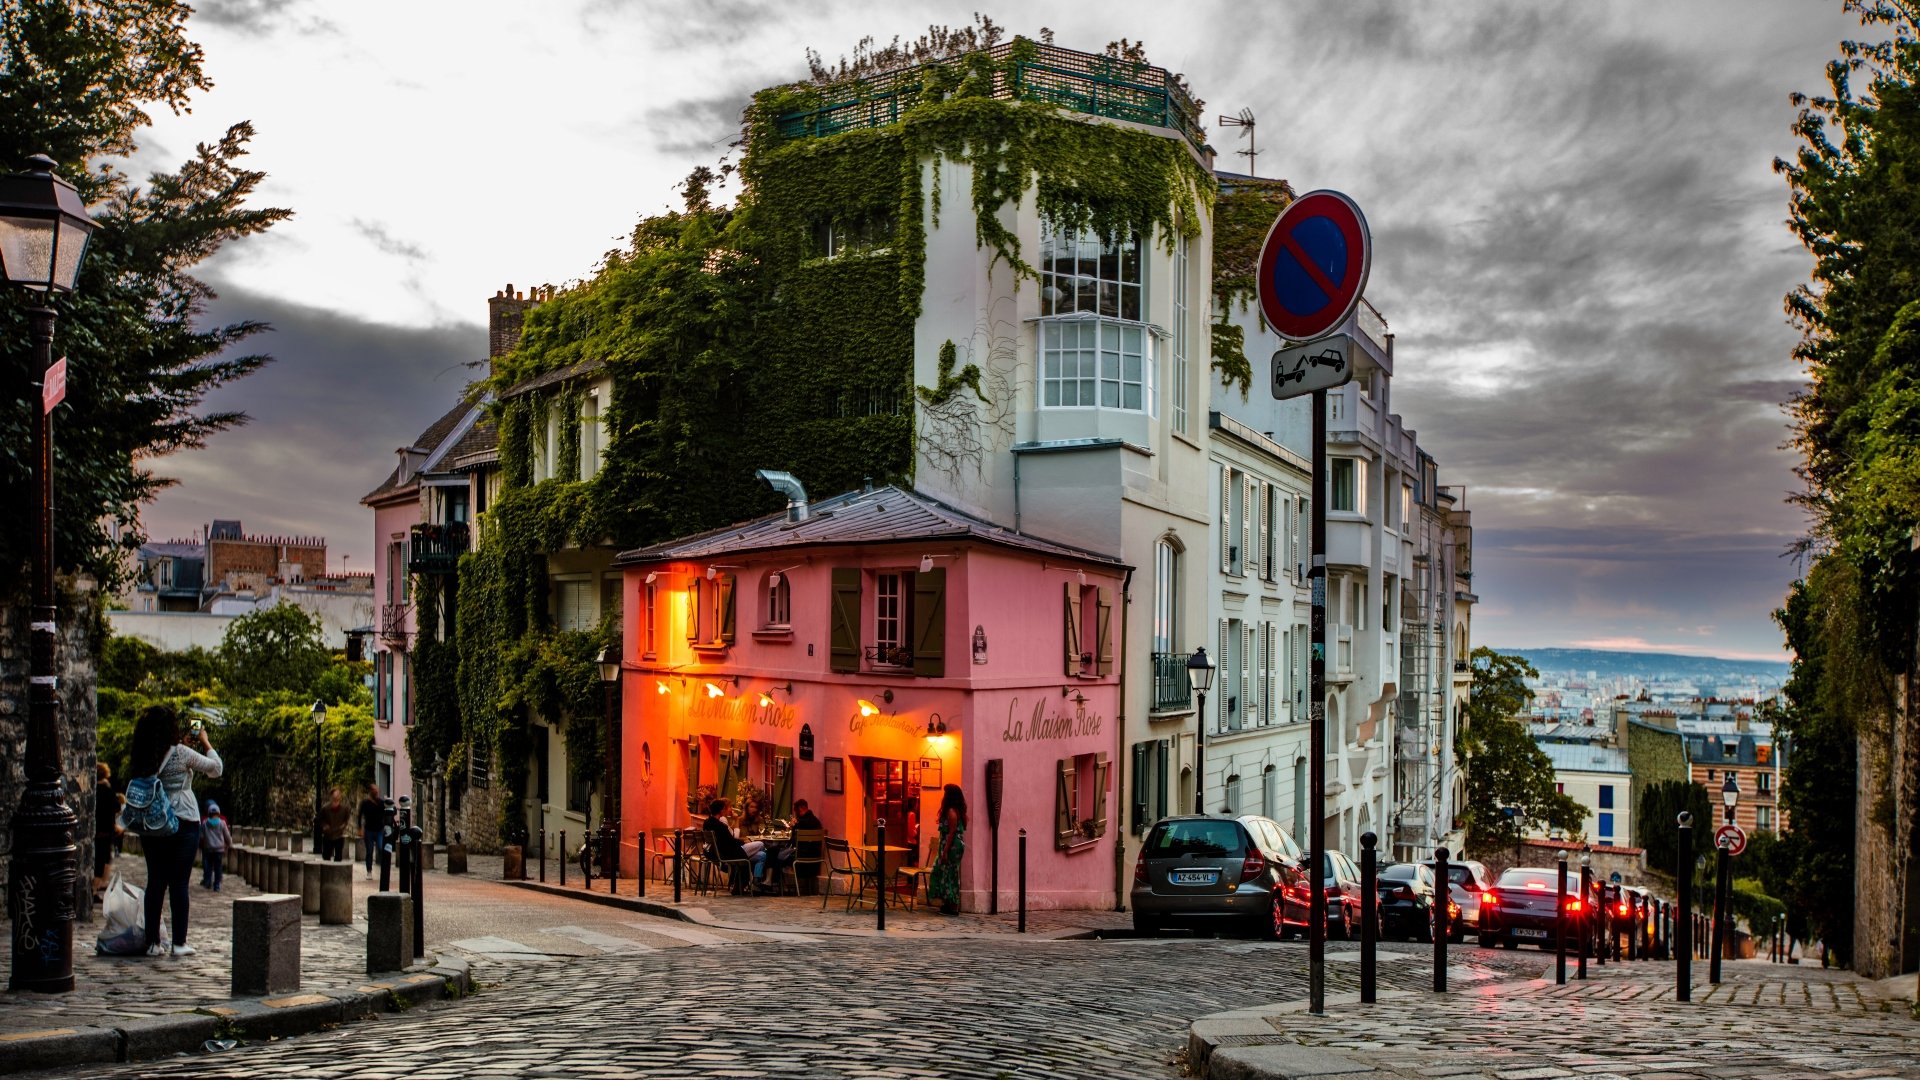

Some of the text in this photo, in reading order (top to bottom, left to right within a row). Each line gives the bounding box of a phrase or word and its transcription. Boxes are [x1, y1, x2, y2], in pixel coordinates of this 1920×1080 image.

[688, 679, 706, 720] La
[759, 701, 795, 730] Rose
[1003, 696, 1101, 742] La Maison Rose
